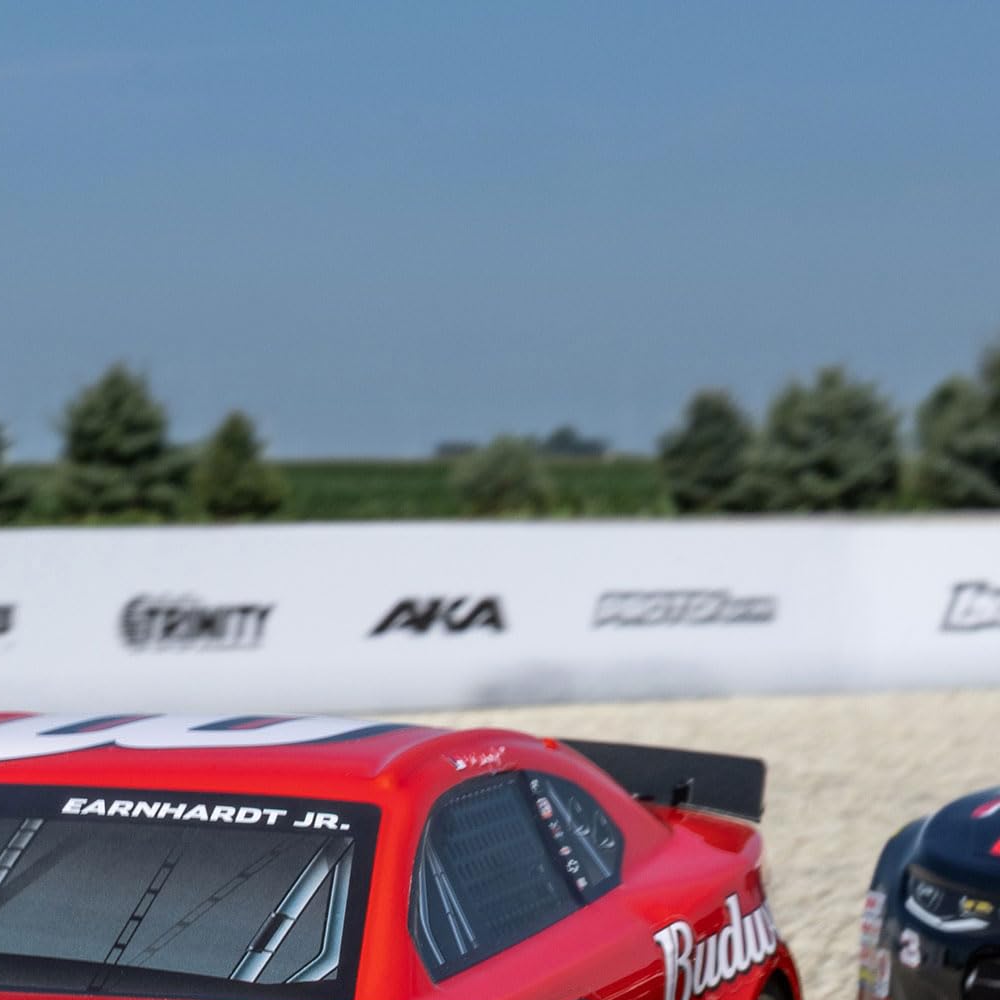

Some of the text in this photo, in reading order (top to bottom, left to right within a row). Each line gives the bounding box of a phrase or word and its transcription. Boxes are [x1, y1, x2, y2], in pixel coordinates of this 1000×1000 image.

[370, 595, 507, 636] AKA
[62, 798, 350, 831] EARNHARDT JR.
